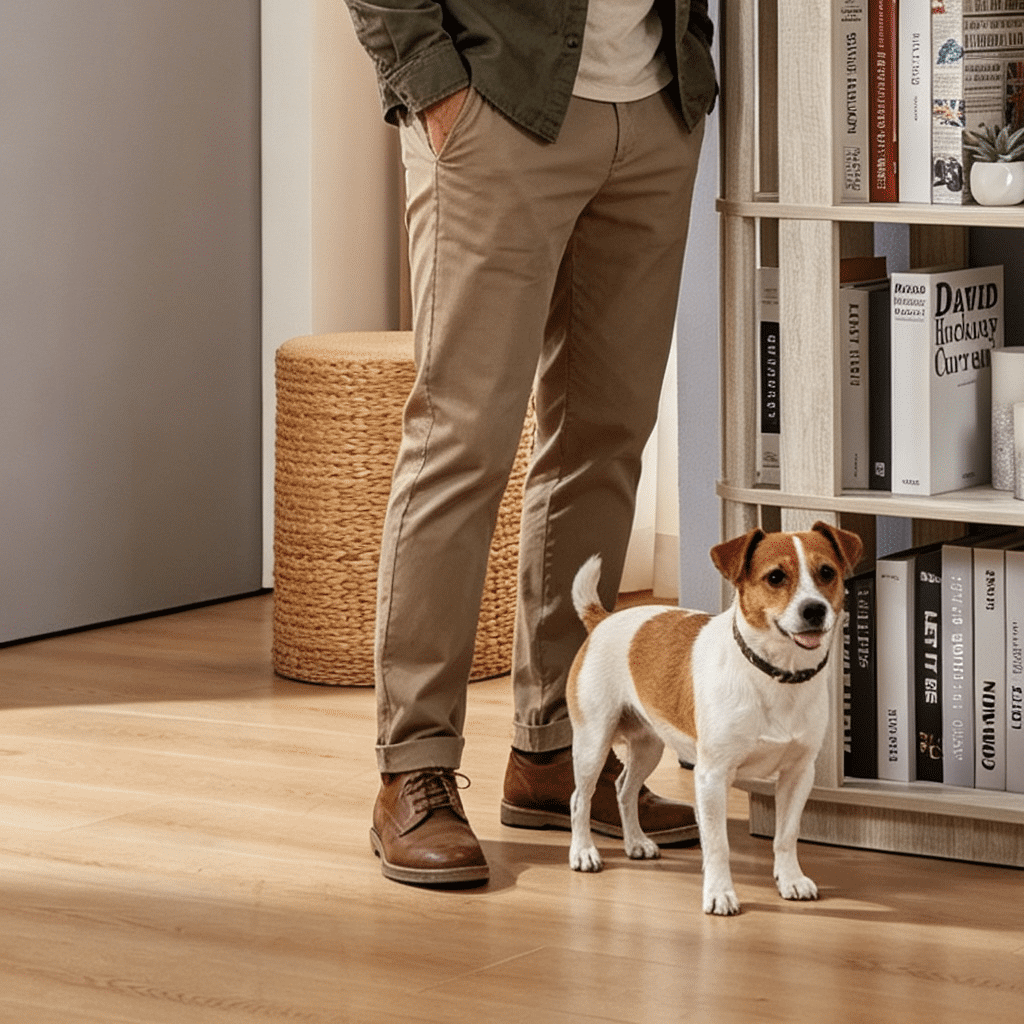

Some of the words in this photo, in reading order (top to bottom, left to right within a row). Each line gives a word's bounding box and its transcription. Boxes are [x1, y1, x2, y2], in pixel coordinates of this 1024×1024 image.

[935, 282, 998, 317] DAVID
[924, 610, 938, 648] LET
[924, 653, 938, 673] IT
[925, 679, 937, 704] BE
